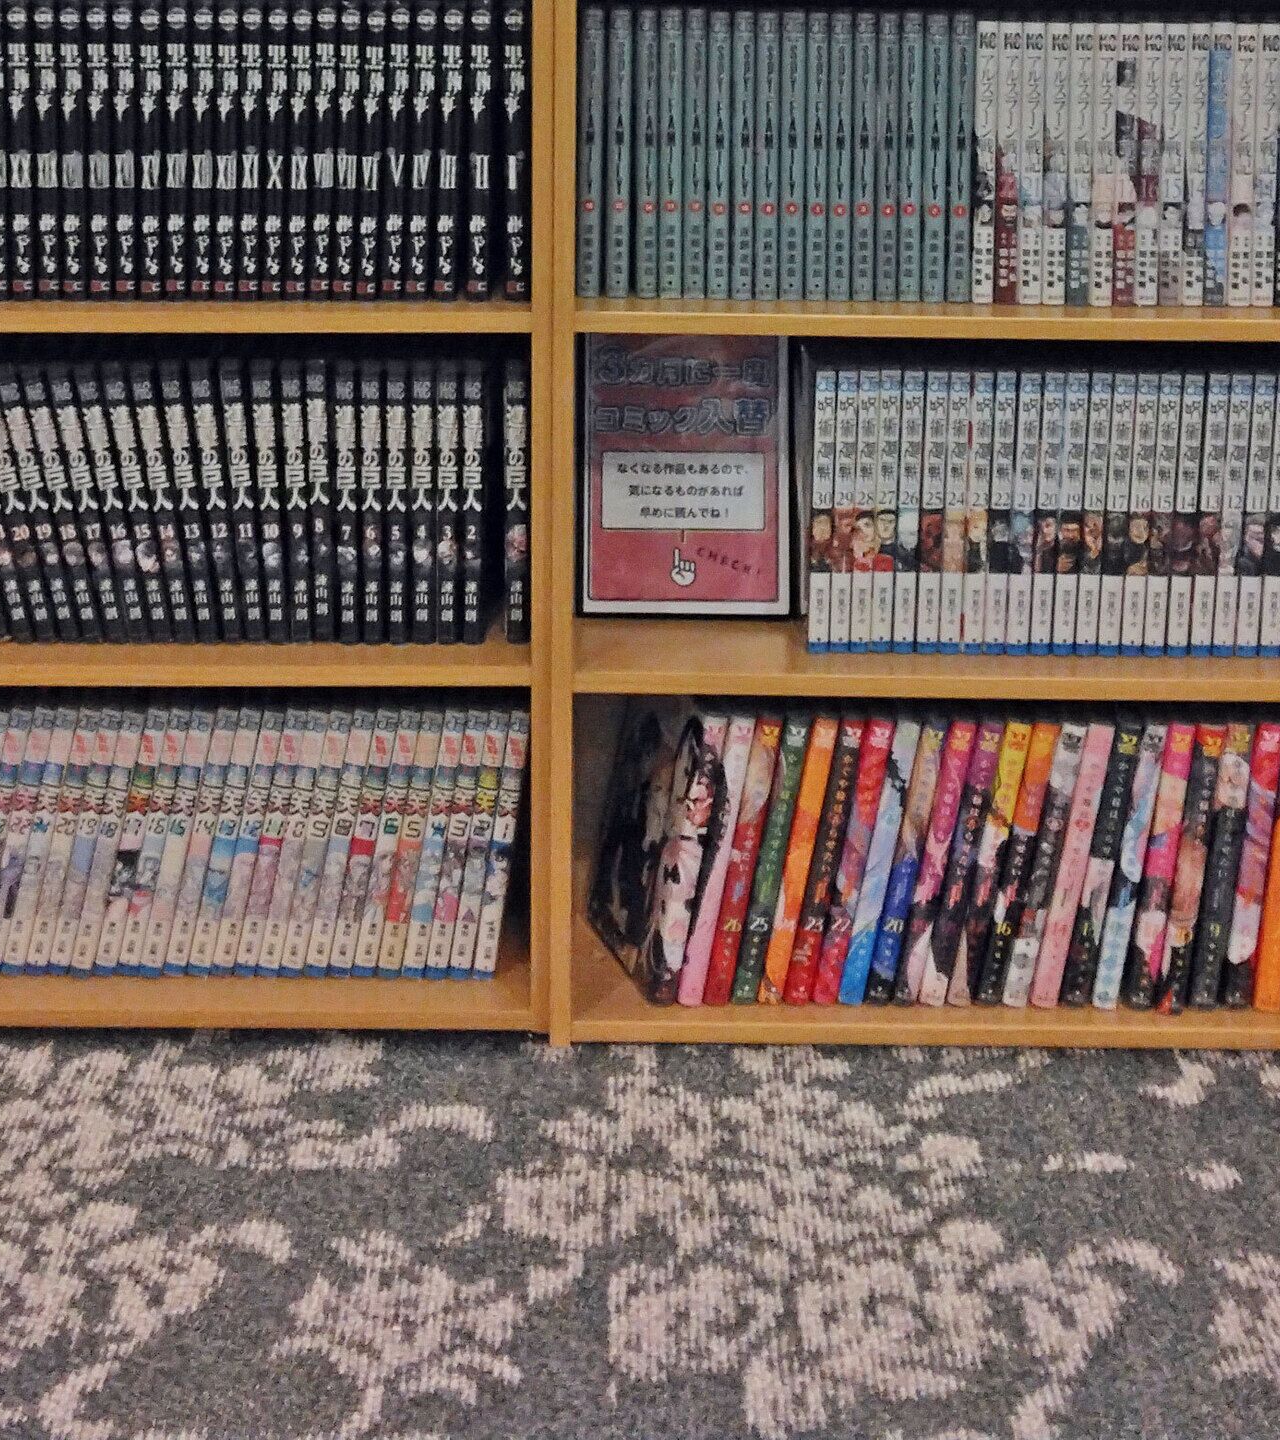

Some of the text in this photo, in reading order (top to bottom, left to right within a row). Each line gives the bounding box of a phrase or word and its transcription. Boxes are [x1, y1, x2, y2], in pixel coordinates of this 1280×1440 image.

[817, 491, 833, 506] 30
[879, 491, 895, 505] 27
[926, 491, 942, 506] 25
[995, 493, 1010, 506] 22
[1042, 492, 1057, 507] 20
[1089, 494, 1103, 507] 18
[1113, 494, 1126, 508] 17
[1136, 494, 1150, 508] 16
